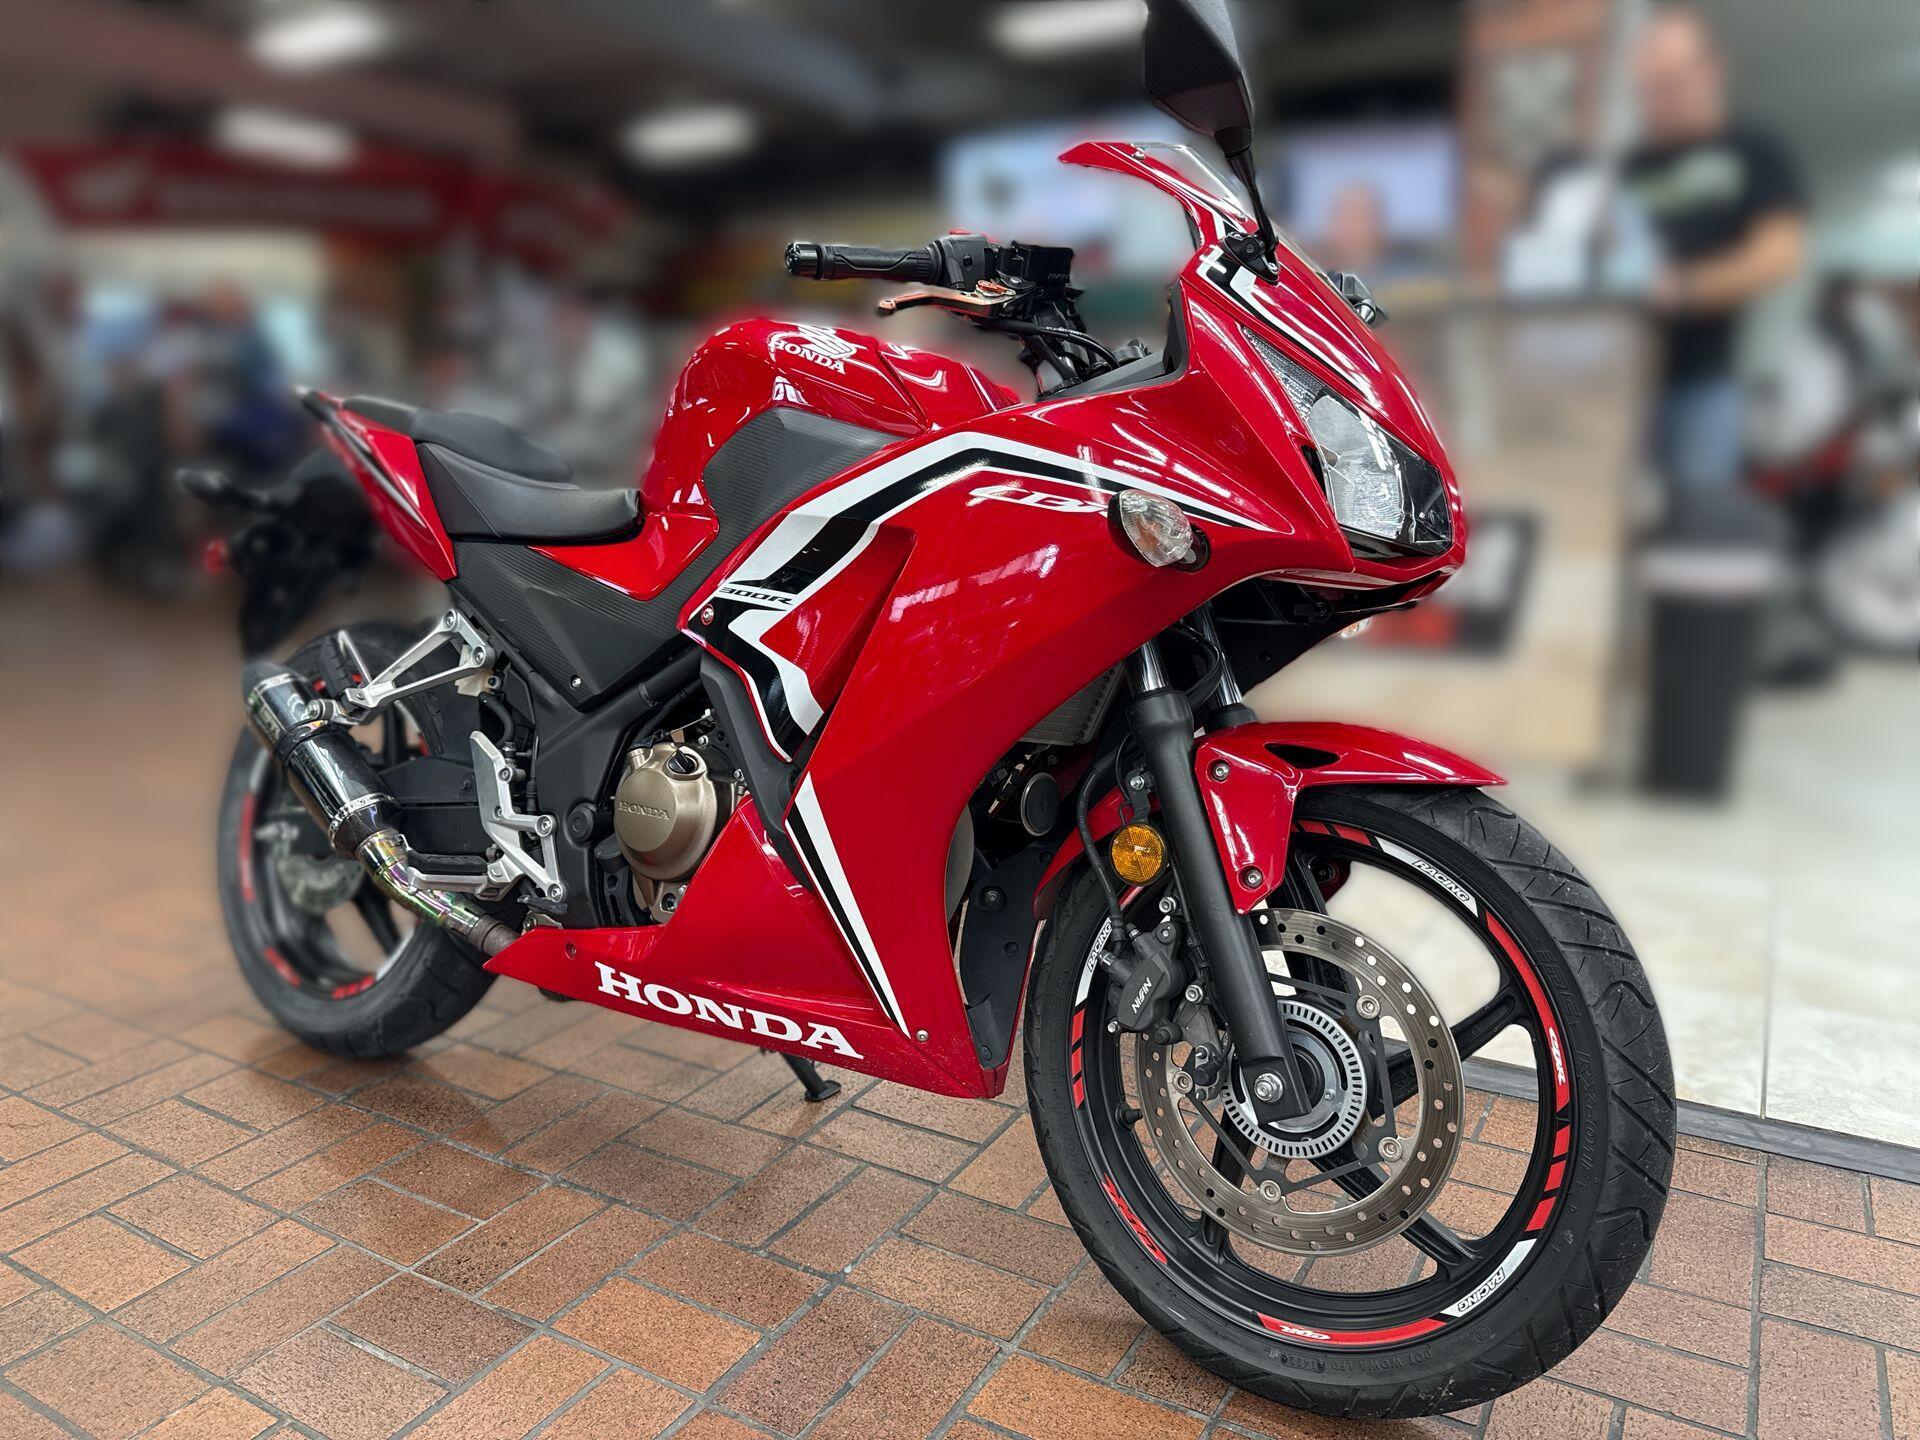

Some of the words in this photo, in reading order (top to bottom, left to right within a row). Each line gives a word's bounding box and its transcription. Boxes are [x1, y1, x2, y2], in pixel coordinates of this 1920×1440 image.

[768, 339, 846, 375] HONDA
[618, 800, 671, 820] HONDA
[1412, 859, 1470, 902] RACING
[1087, 922, 1112, 972] RACING
[594, 961, 864, 1060] HONDA
[1132, 977, 1152, 1014] NISSIN
[1457, 1267, 1506, 1312] RACING
